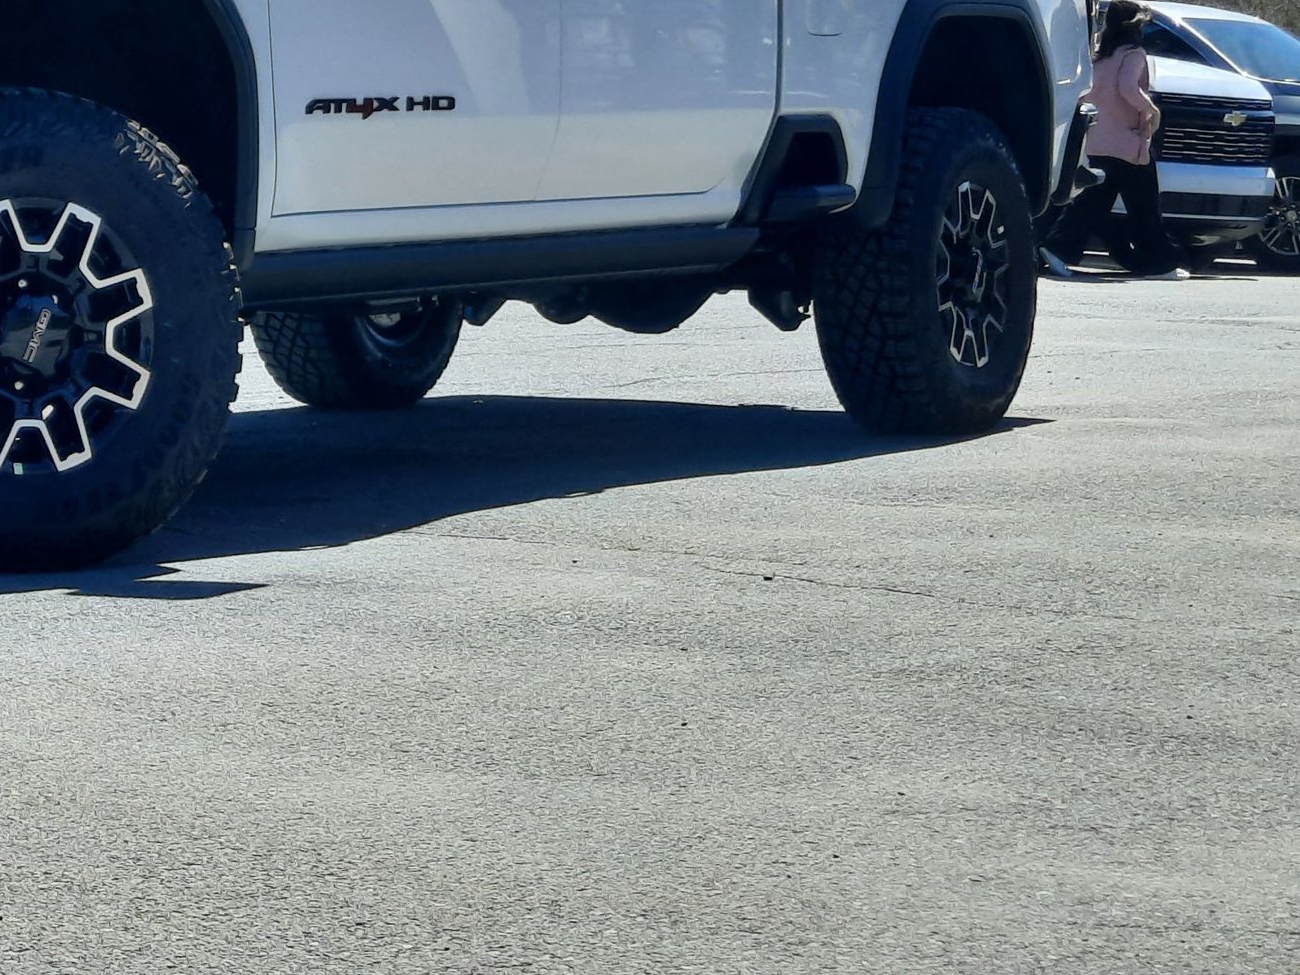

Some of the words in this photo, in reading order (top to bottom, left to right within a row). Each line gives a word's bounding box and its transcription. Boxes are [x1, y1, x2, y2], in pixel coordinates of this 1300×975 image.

[305, 96, 400, 120] AT4X
[406, 96, 456, 112] HD
[22, 308, 52, 363] GMC
